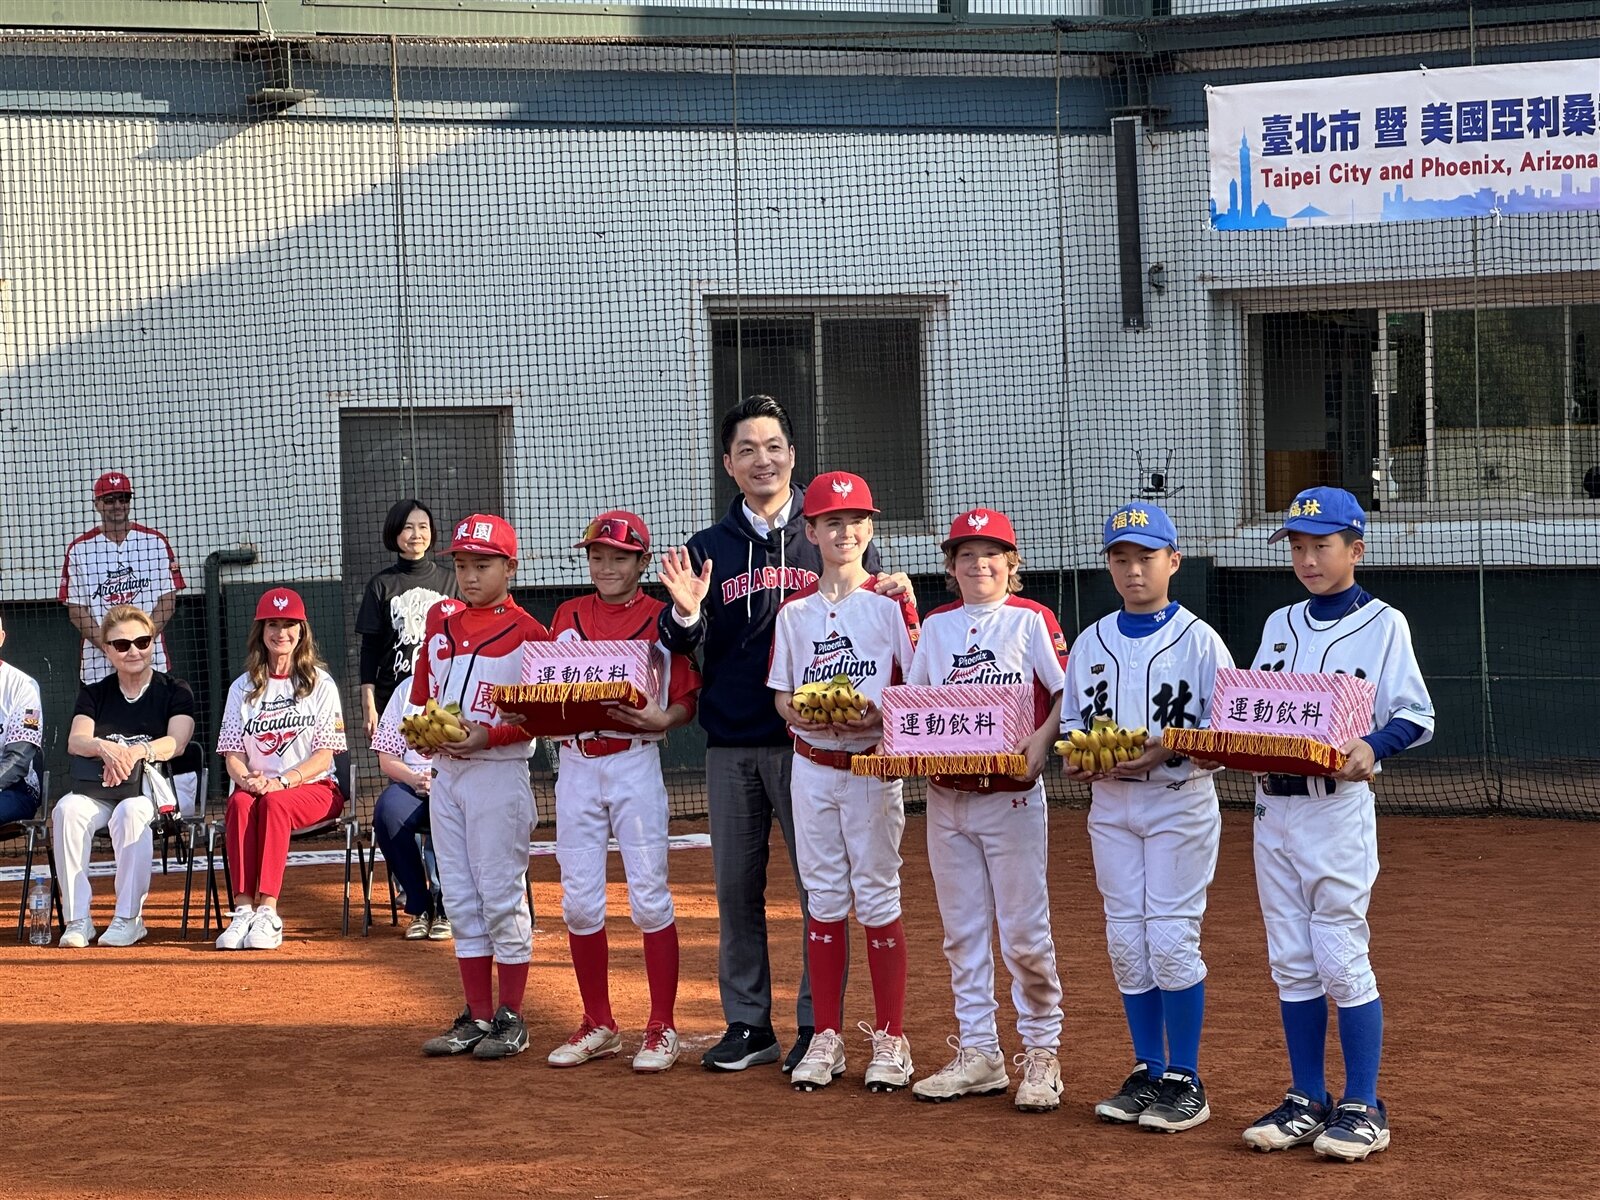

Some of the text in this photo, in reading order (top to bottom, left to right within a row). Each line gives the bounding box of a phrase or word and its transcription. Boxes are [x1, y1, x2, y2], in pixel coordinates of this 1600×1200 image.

[1262, 93, 1600, 156] 臺北市 暨 美國亞利桑
[1261, 149, 1598, 190] Taipei City and Phoenix, Arizona
[1111, 508, 1149, 532] 福林
[818, 637, 847, 654] Phoenix
[958, 651, 988, 667] Phoenix
[536, 664, 629, 684] 運動飲料
[241, 711, 316, 737] Arcadians
[900, 711, 996, 736] 運動飲料
[1227, 697, 1323, 728] 運動飲料
[978, 776, 990, 788] 20
